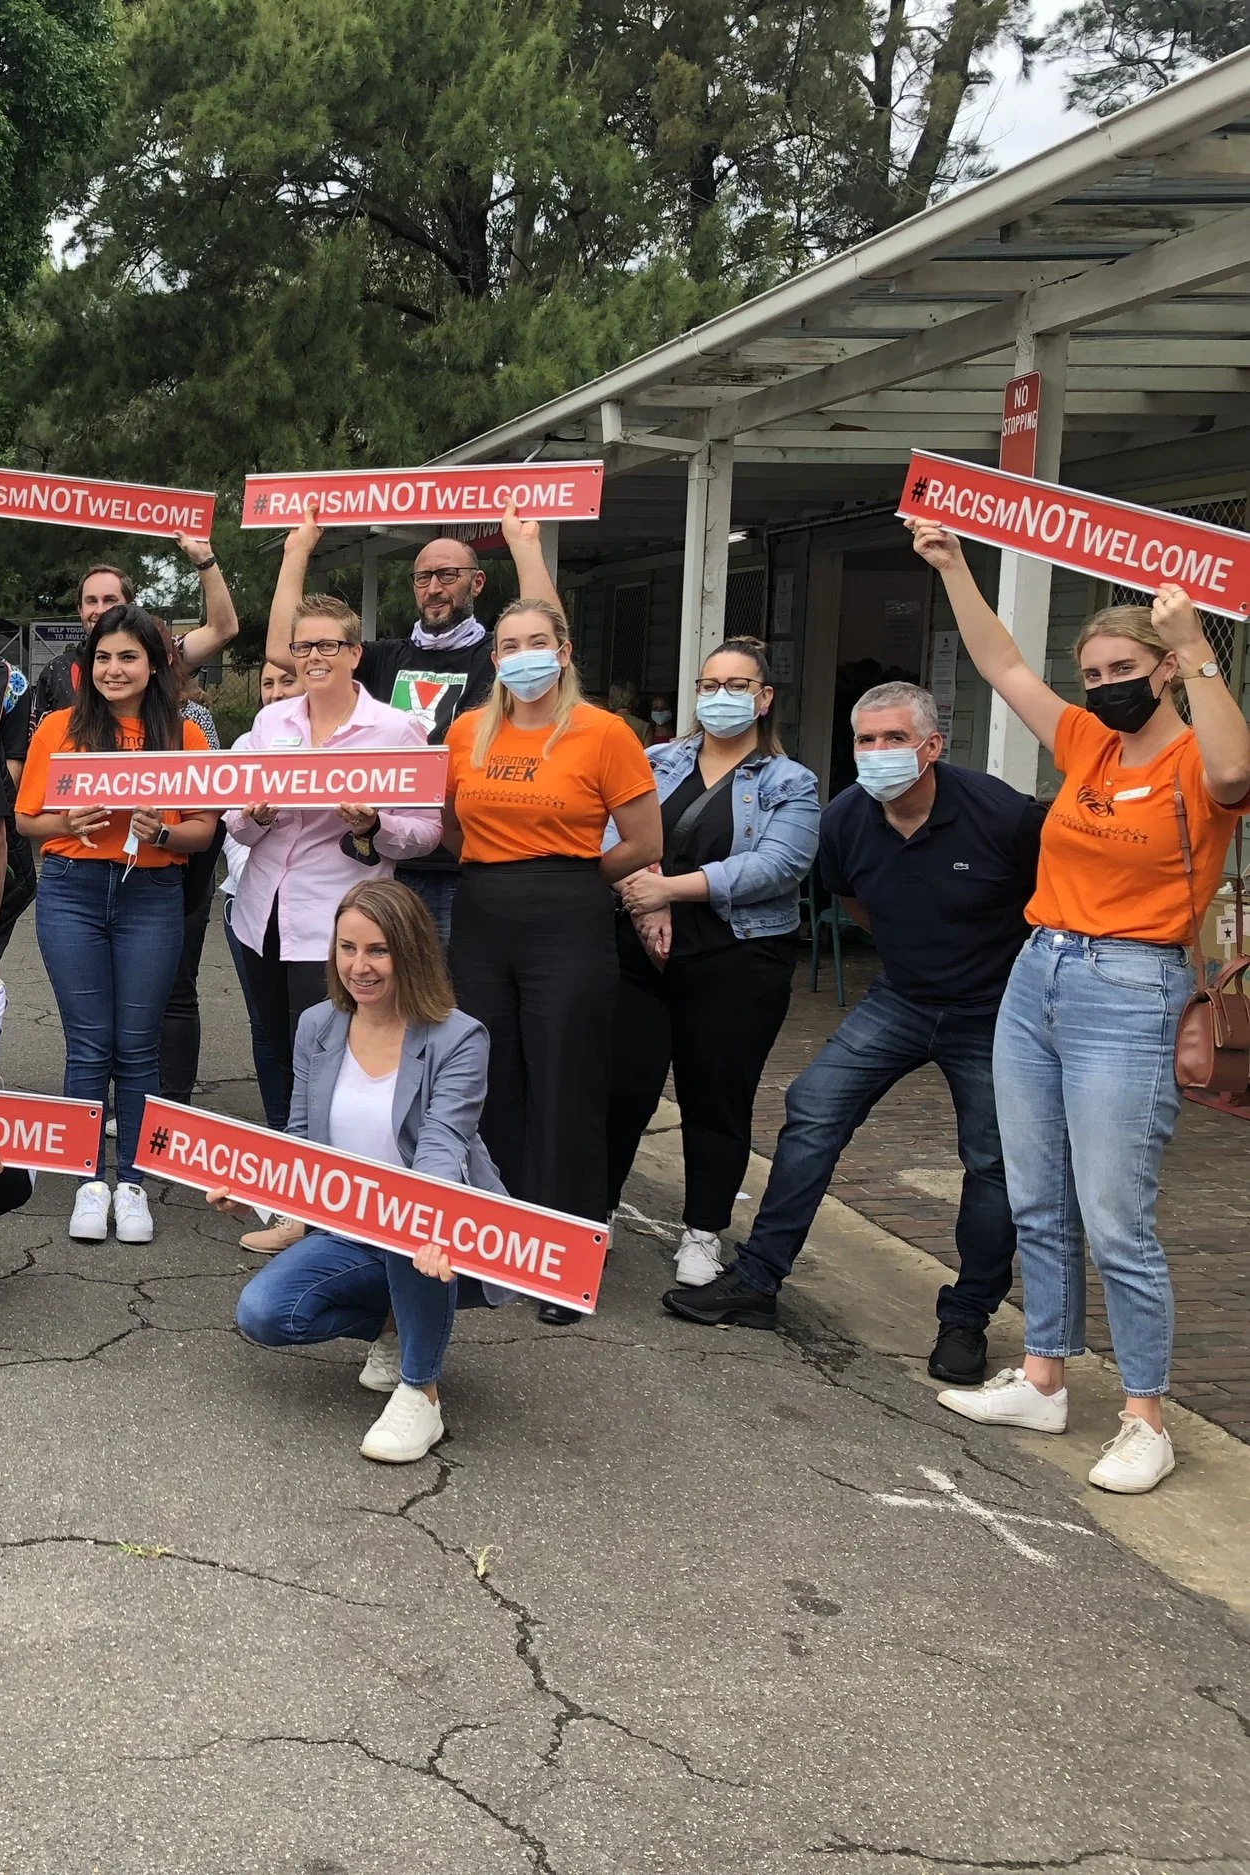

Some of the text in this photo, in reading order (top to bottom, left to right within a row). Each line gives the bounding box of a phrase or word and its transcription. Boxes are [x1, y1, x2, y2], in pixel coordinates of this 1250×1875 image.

[1014, 384, 1029, 409] NO
[1002, 409, 1038, 437] STOPPING
[253, 481, 575, 515] #RACISMNOTWELCOME
[912, 476, 1234, 593] #RACISMNOTWELCOME
[398, 670, 466, 684] Free Palestine
[56, 763, 417, 796] #RACISMNOTWELCOME
[485, 765, 539, 782] WEEK
[149, 1126, 566, 1281] #RACISMNOTWELCOME
